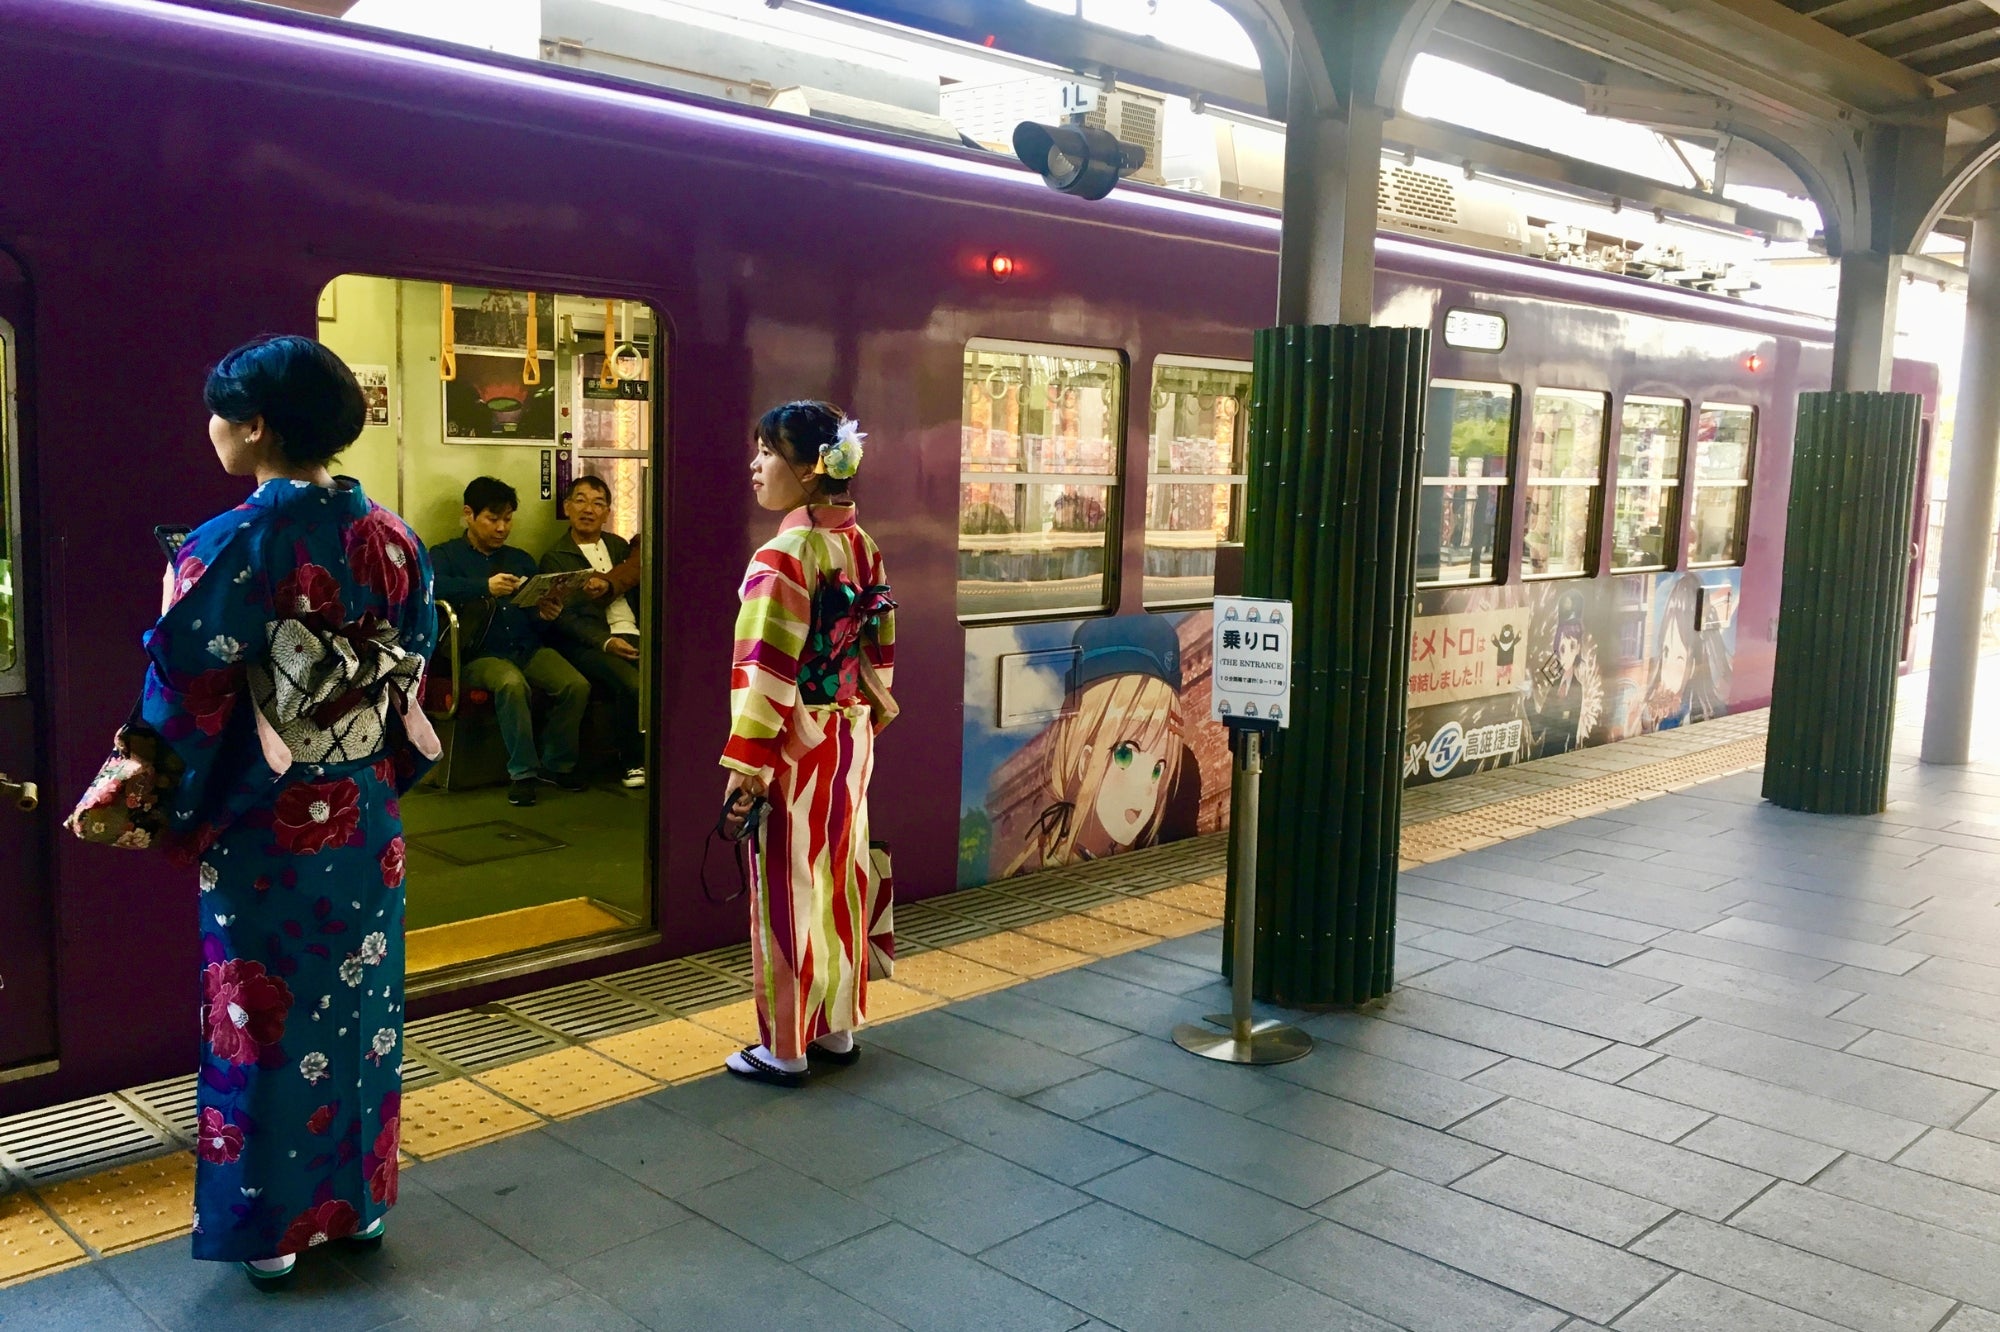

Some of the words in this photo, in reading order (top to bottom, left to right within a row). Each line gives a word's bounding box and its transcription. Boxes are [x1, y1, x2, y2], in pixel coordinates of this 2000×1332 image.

[1223, 630, 1279, 652] 乗り口
[1465, 723, 1520, 757] 高雄捷運
